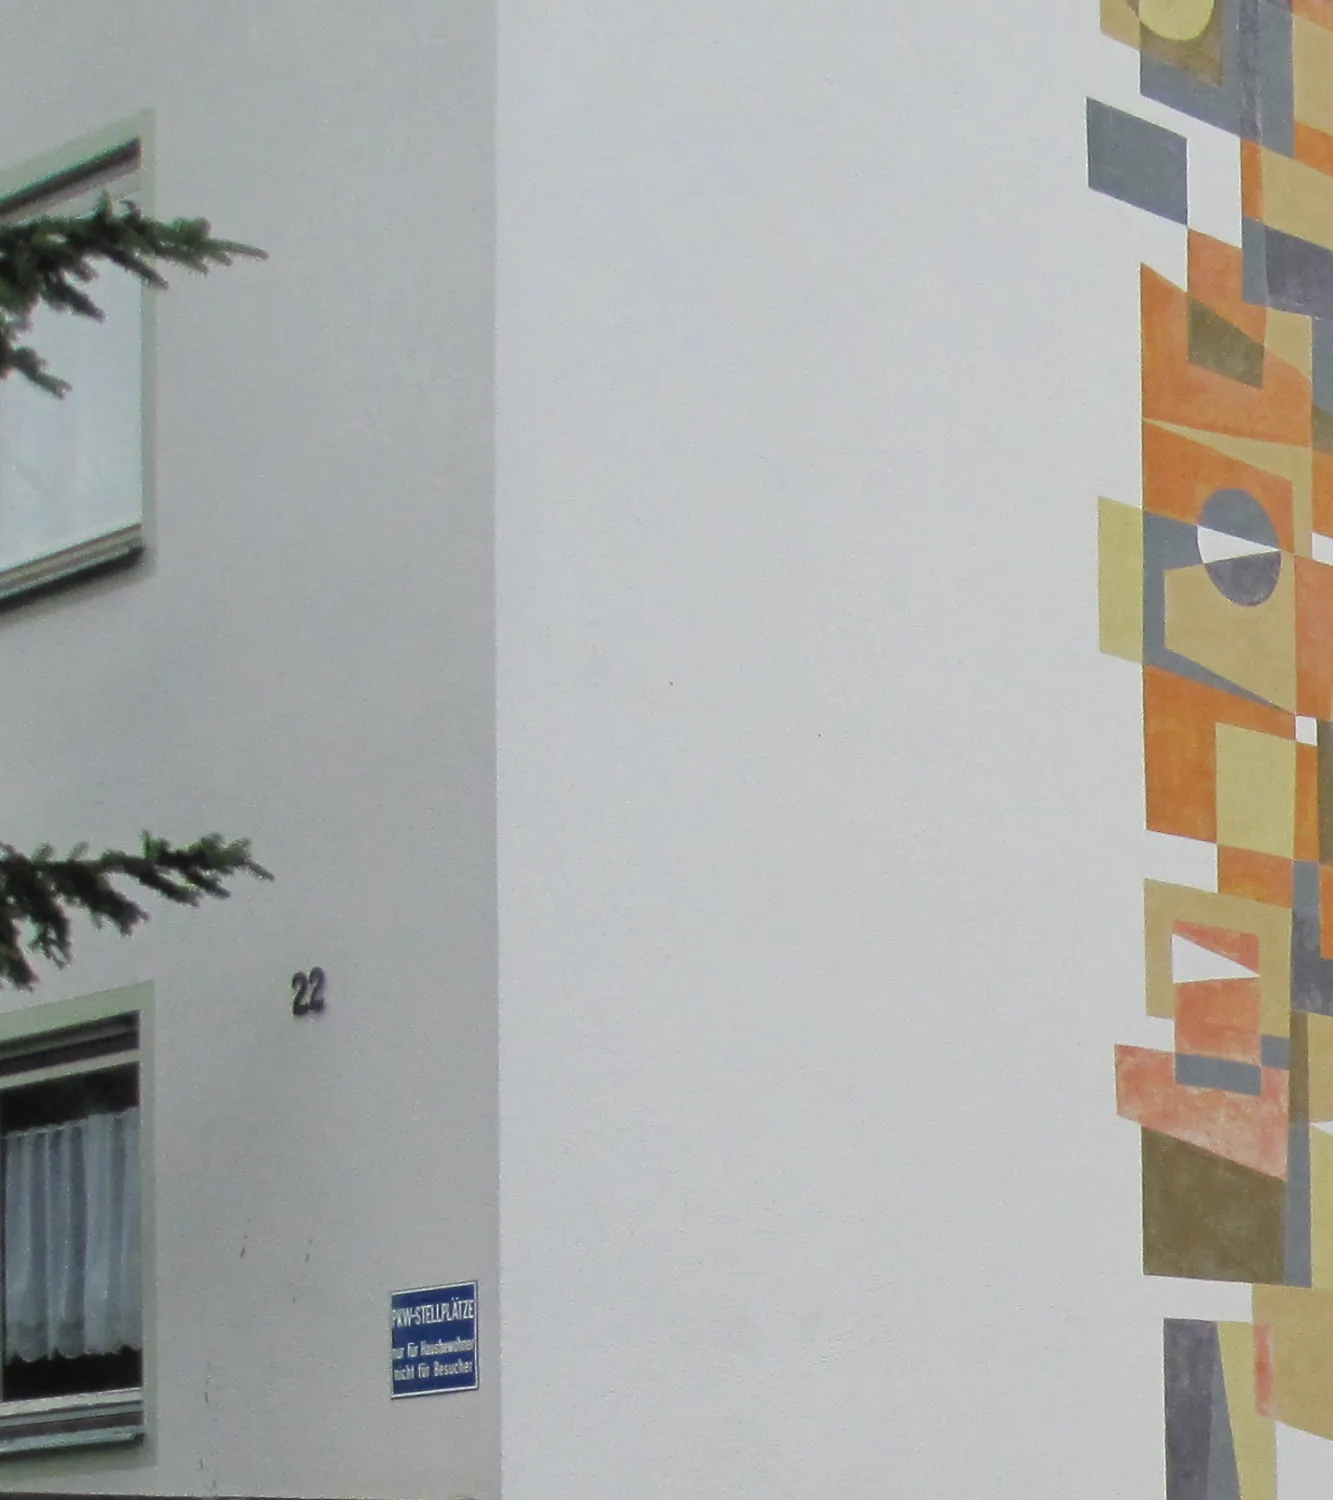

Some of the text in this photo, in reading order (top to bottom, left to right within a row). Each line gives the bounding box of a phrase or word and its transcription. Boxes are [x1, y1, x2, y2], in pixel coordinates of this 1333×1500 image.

[292, 966, 326, 1017] 22
[392, 1297, 475, 1328] PKW-STELLPLÄTZE
[419, 1362, 430, 1378] für
[434, 1359, 473, 1376] Besucher
